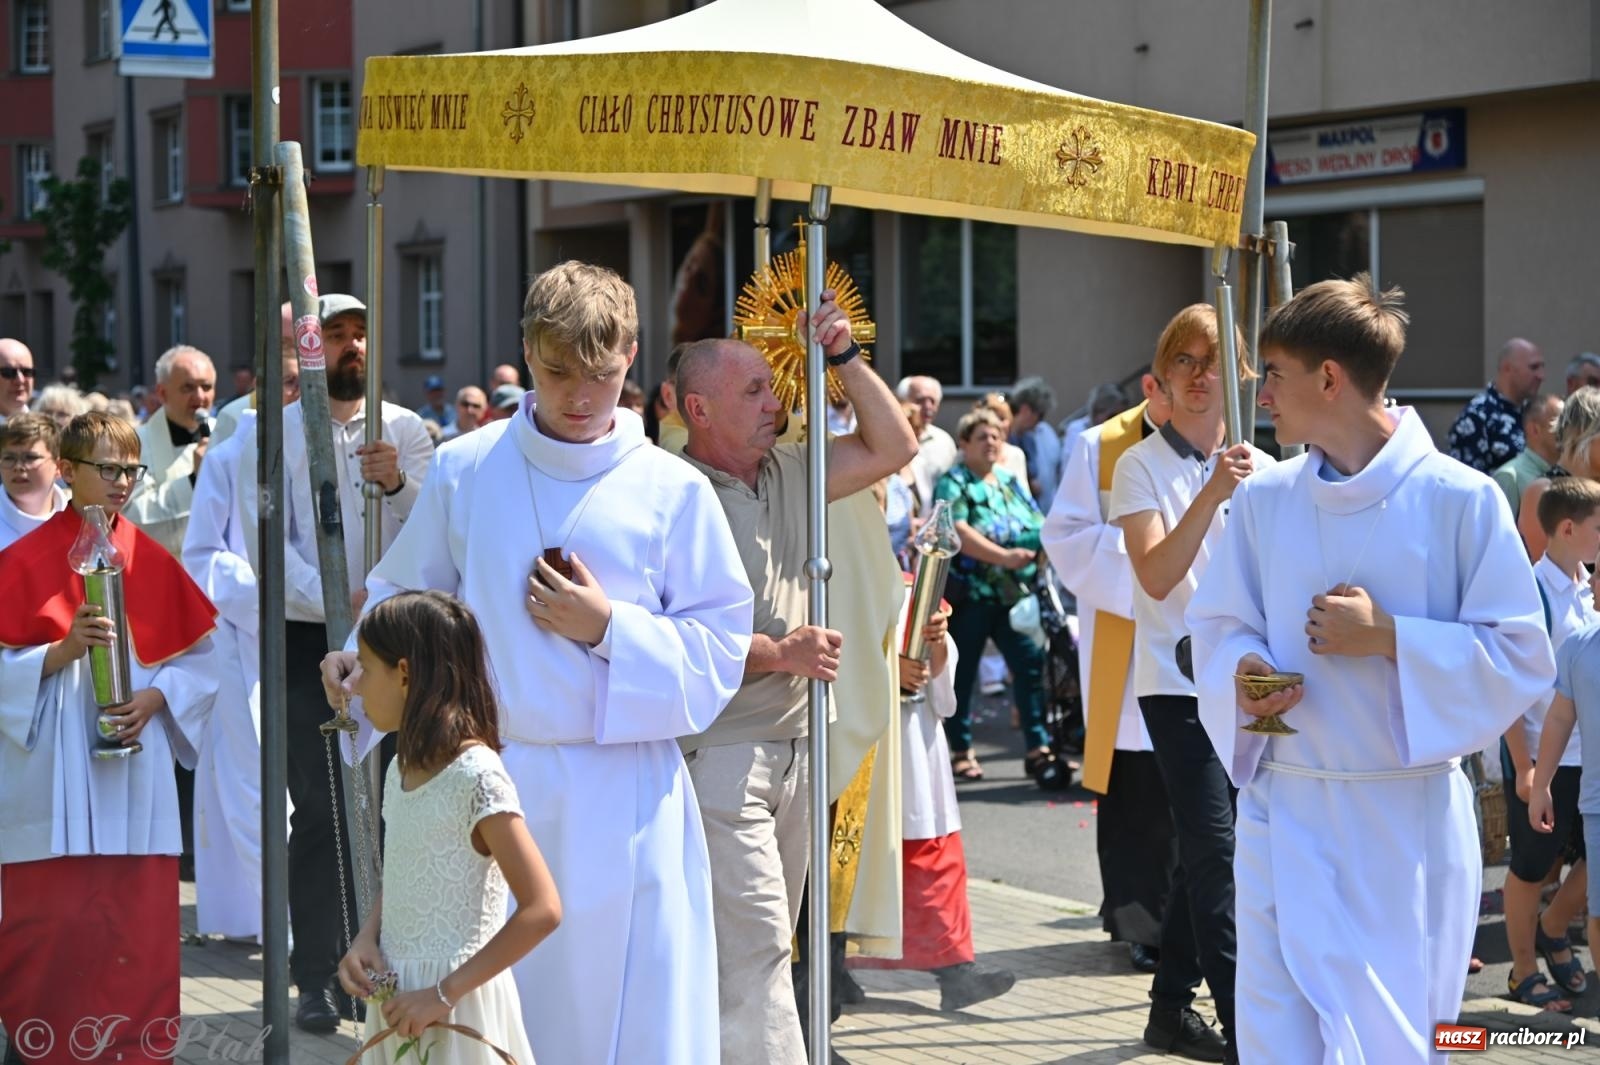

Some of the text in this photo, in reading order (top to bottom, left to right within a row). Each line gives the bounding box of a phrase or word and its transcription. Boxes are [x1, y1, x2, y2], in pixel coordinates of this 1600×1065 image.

[378, 89, 425, 133] UŚWIĘĆ
[430, 94, 469, 130] MNIE
[579, 94, 1003, 166] CIAŁO CHRYSTUSOWE ZBAW MNIE
[1146, 157, 1198, 203] KRWI
